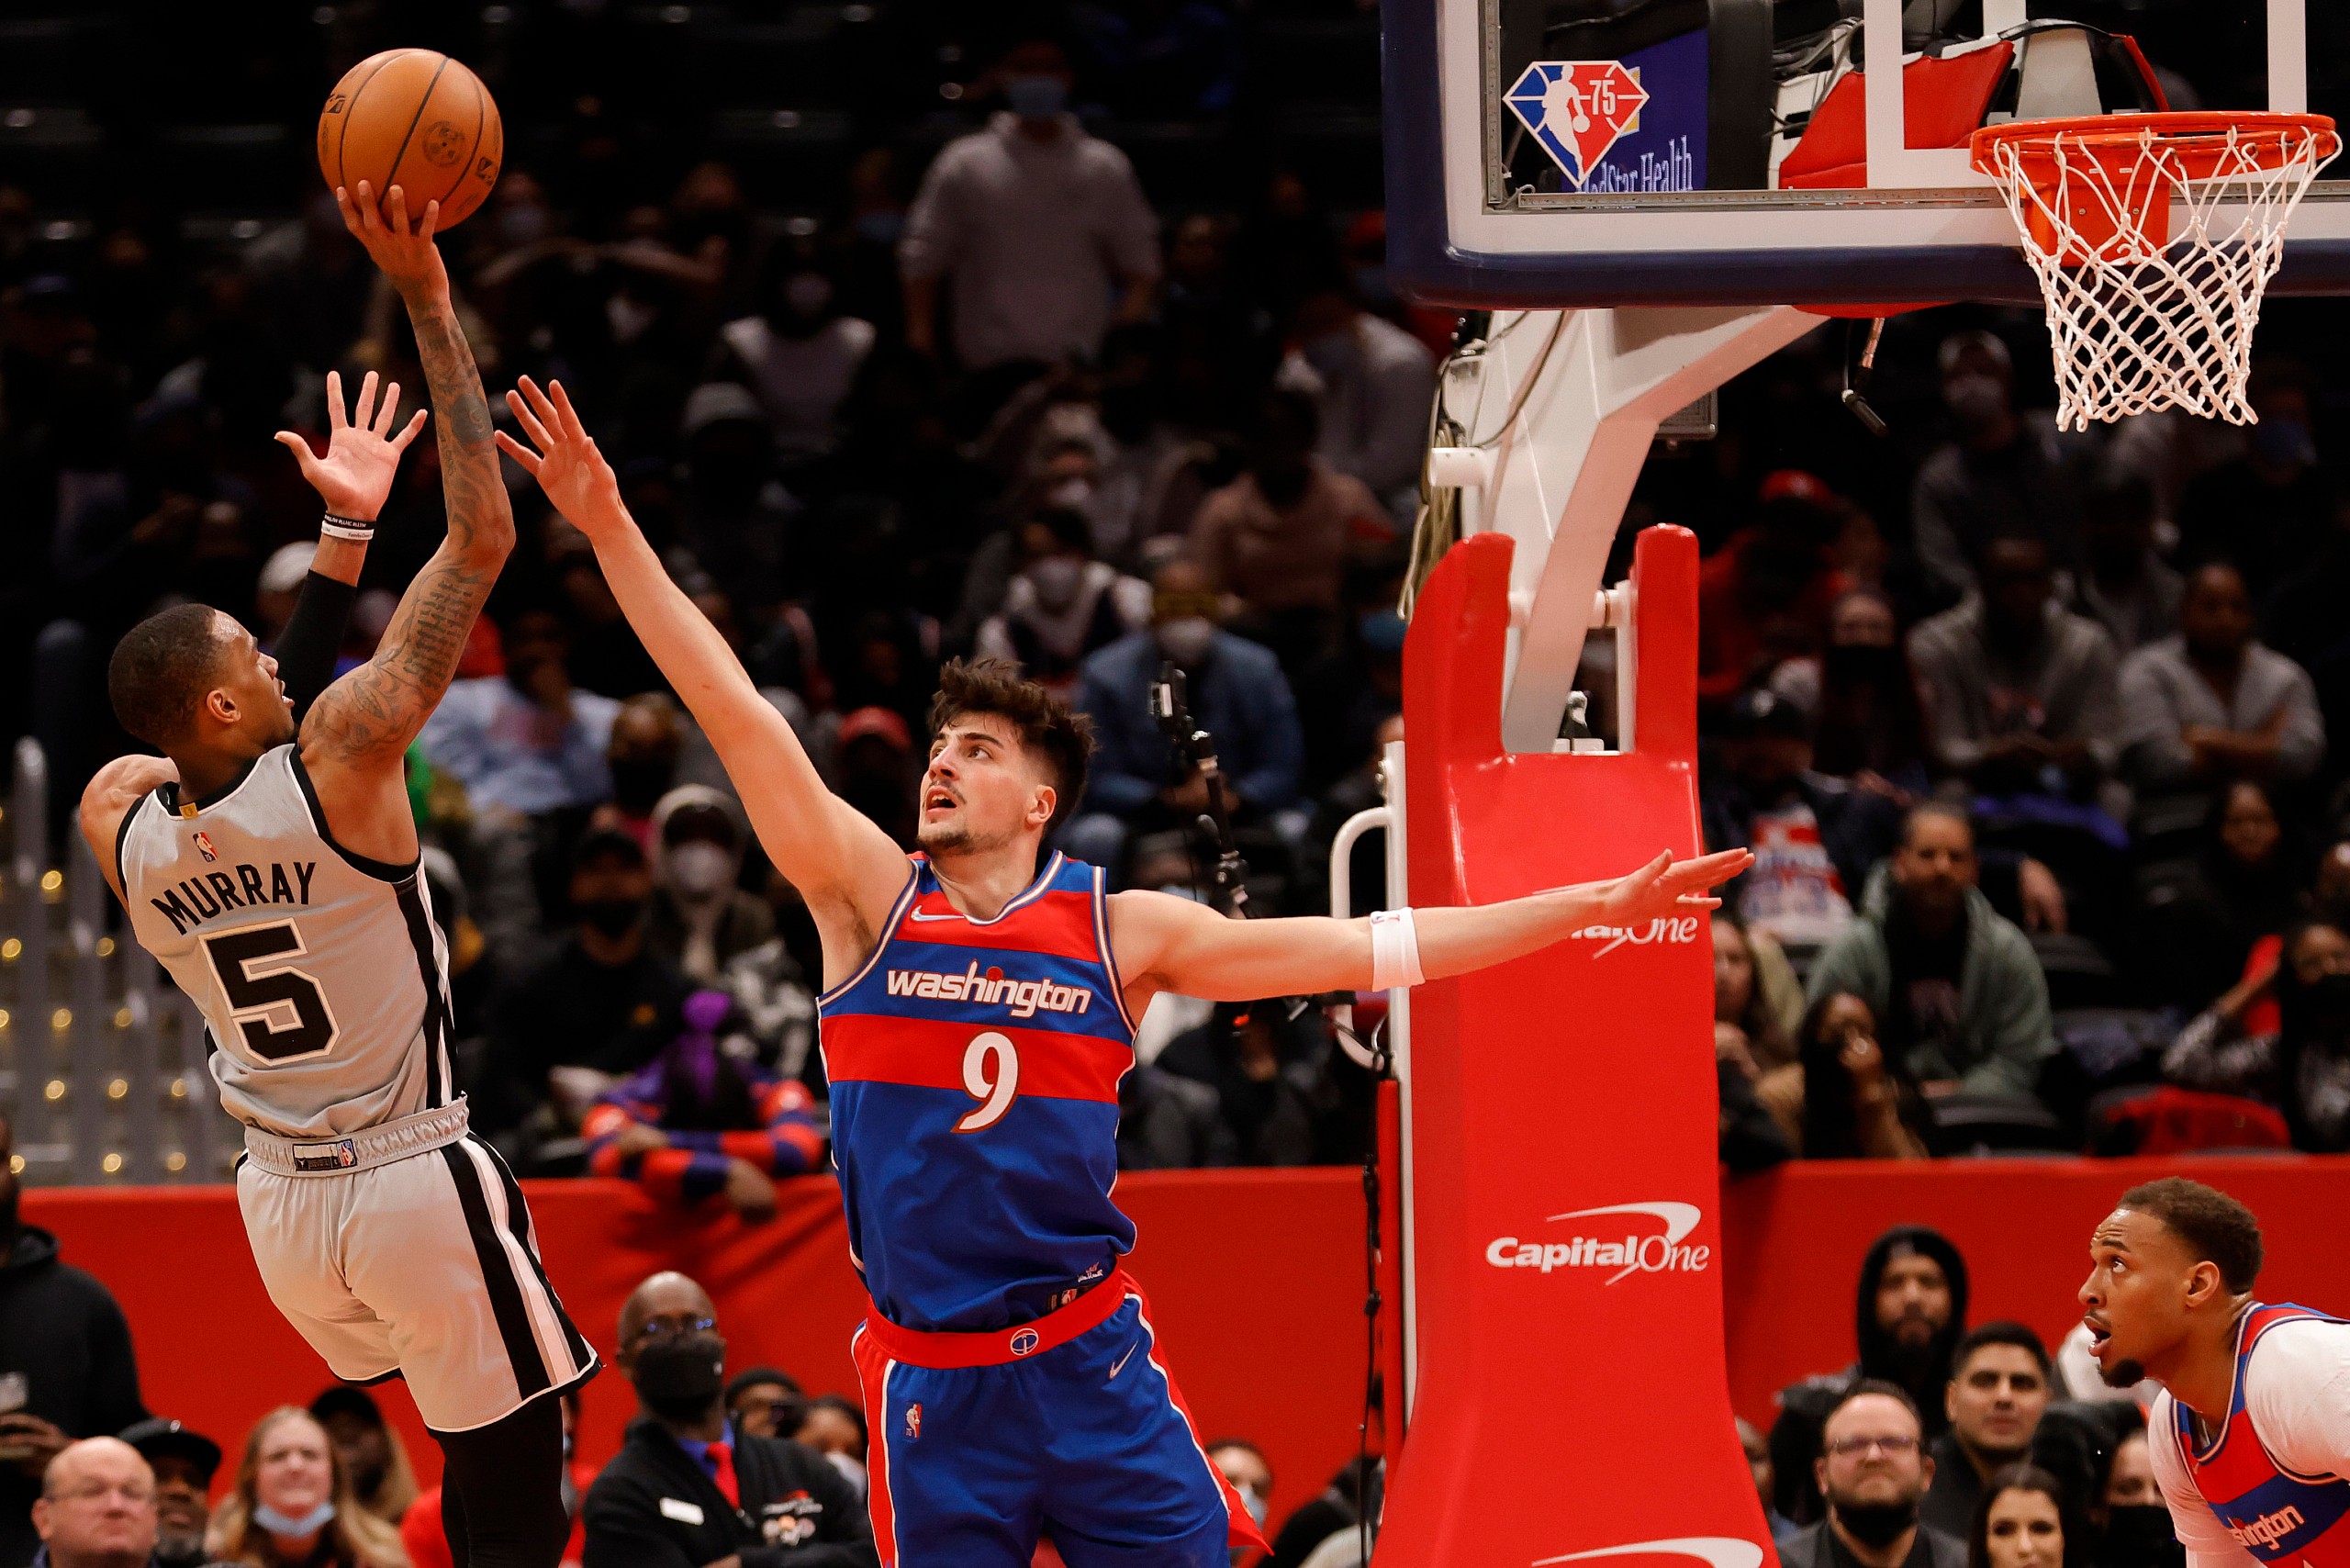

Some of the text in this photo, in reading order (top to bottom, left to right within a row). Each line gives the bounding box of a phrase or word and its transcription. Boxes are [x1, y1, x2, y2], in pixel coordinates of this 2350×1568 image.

[1589, 80, 1617, 115] 75
[1639, 135, 1694, 192] Health
[151, 861, 317, 936] MURRAY
[198, 917, 341, 1067] 5
[886, 958, 1092, 1019] washington
[950, 1028, 1021, 1135] 9
